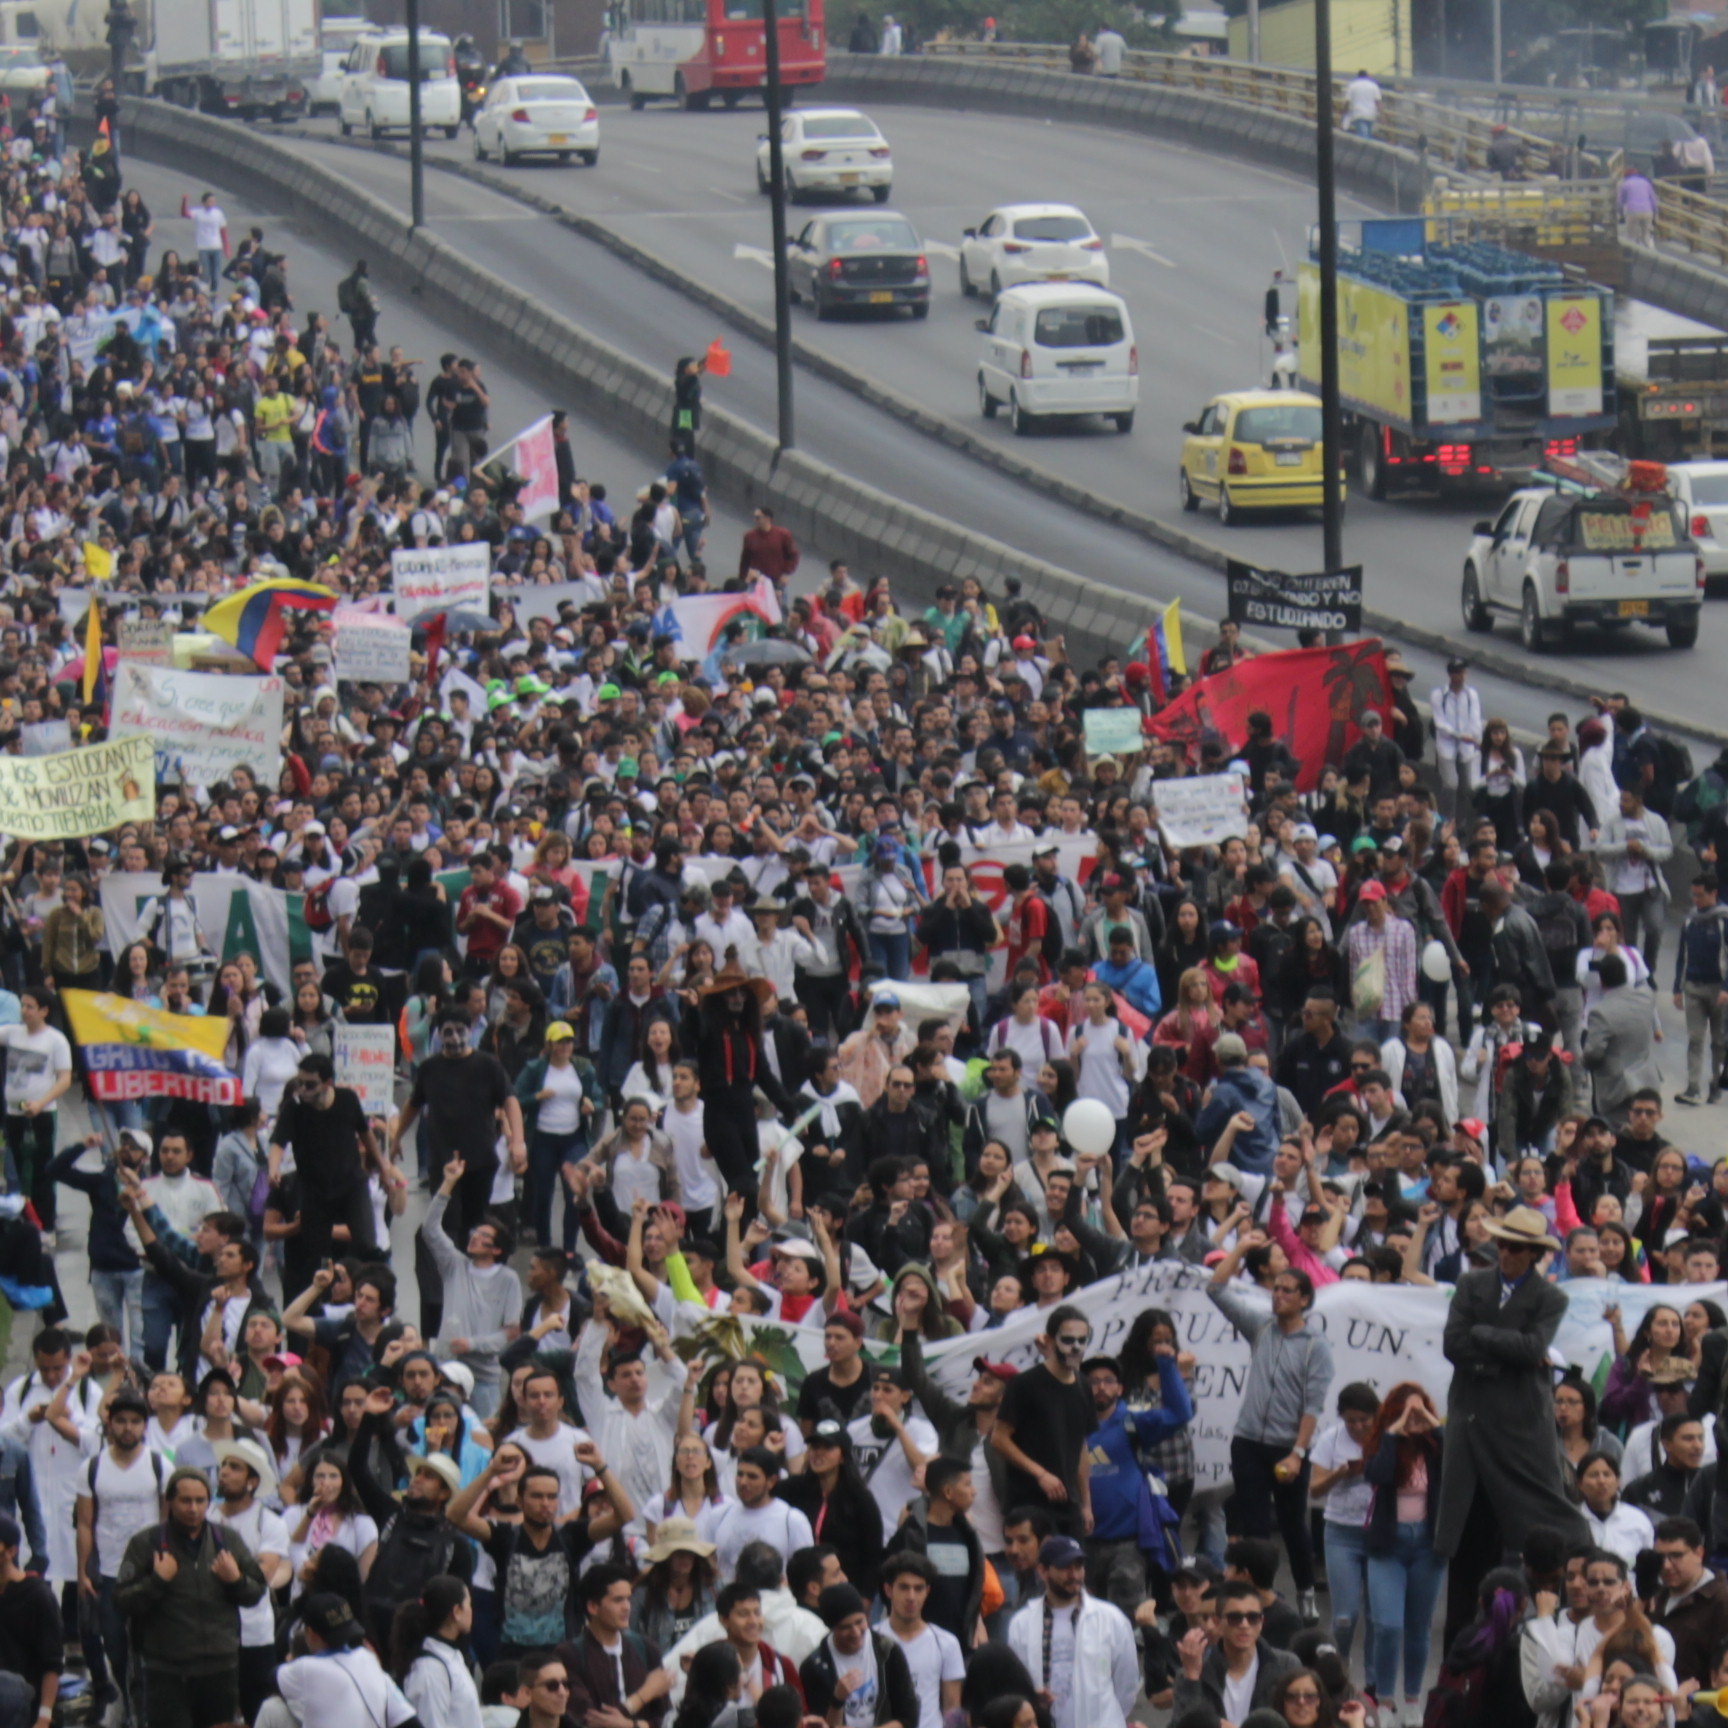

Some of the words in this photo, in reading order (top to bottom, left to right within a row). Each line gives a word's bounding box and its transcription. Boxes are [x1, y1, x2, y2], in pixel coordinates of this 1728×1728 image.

[1585, 513, 1674, 538] PELIRO
[1246, 601, 1347, 630] ESTUDIANDO
[183, 696, 216, 716] cree
[219, 700, 247, 723] que
[251, 694, 266, 718] la
[44, 735, 156, 785] ESTUDIANTES
